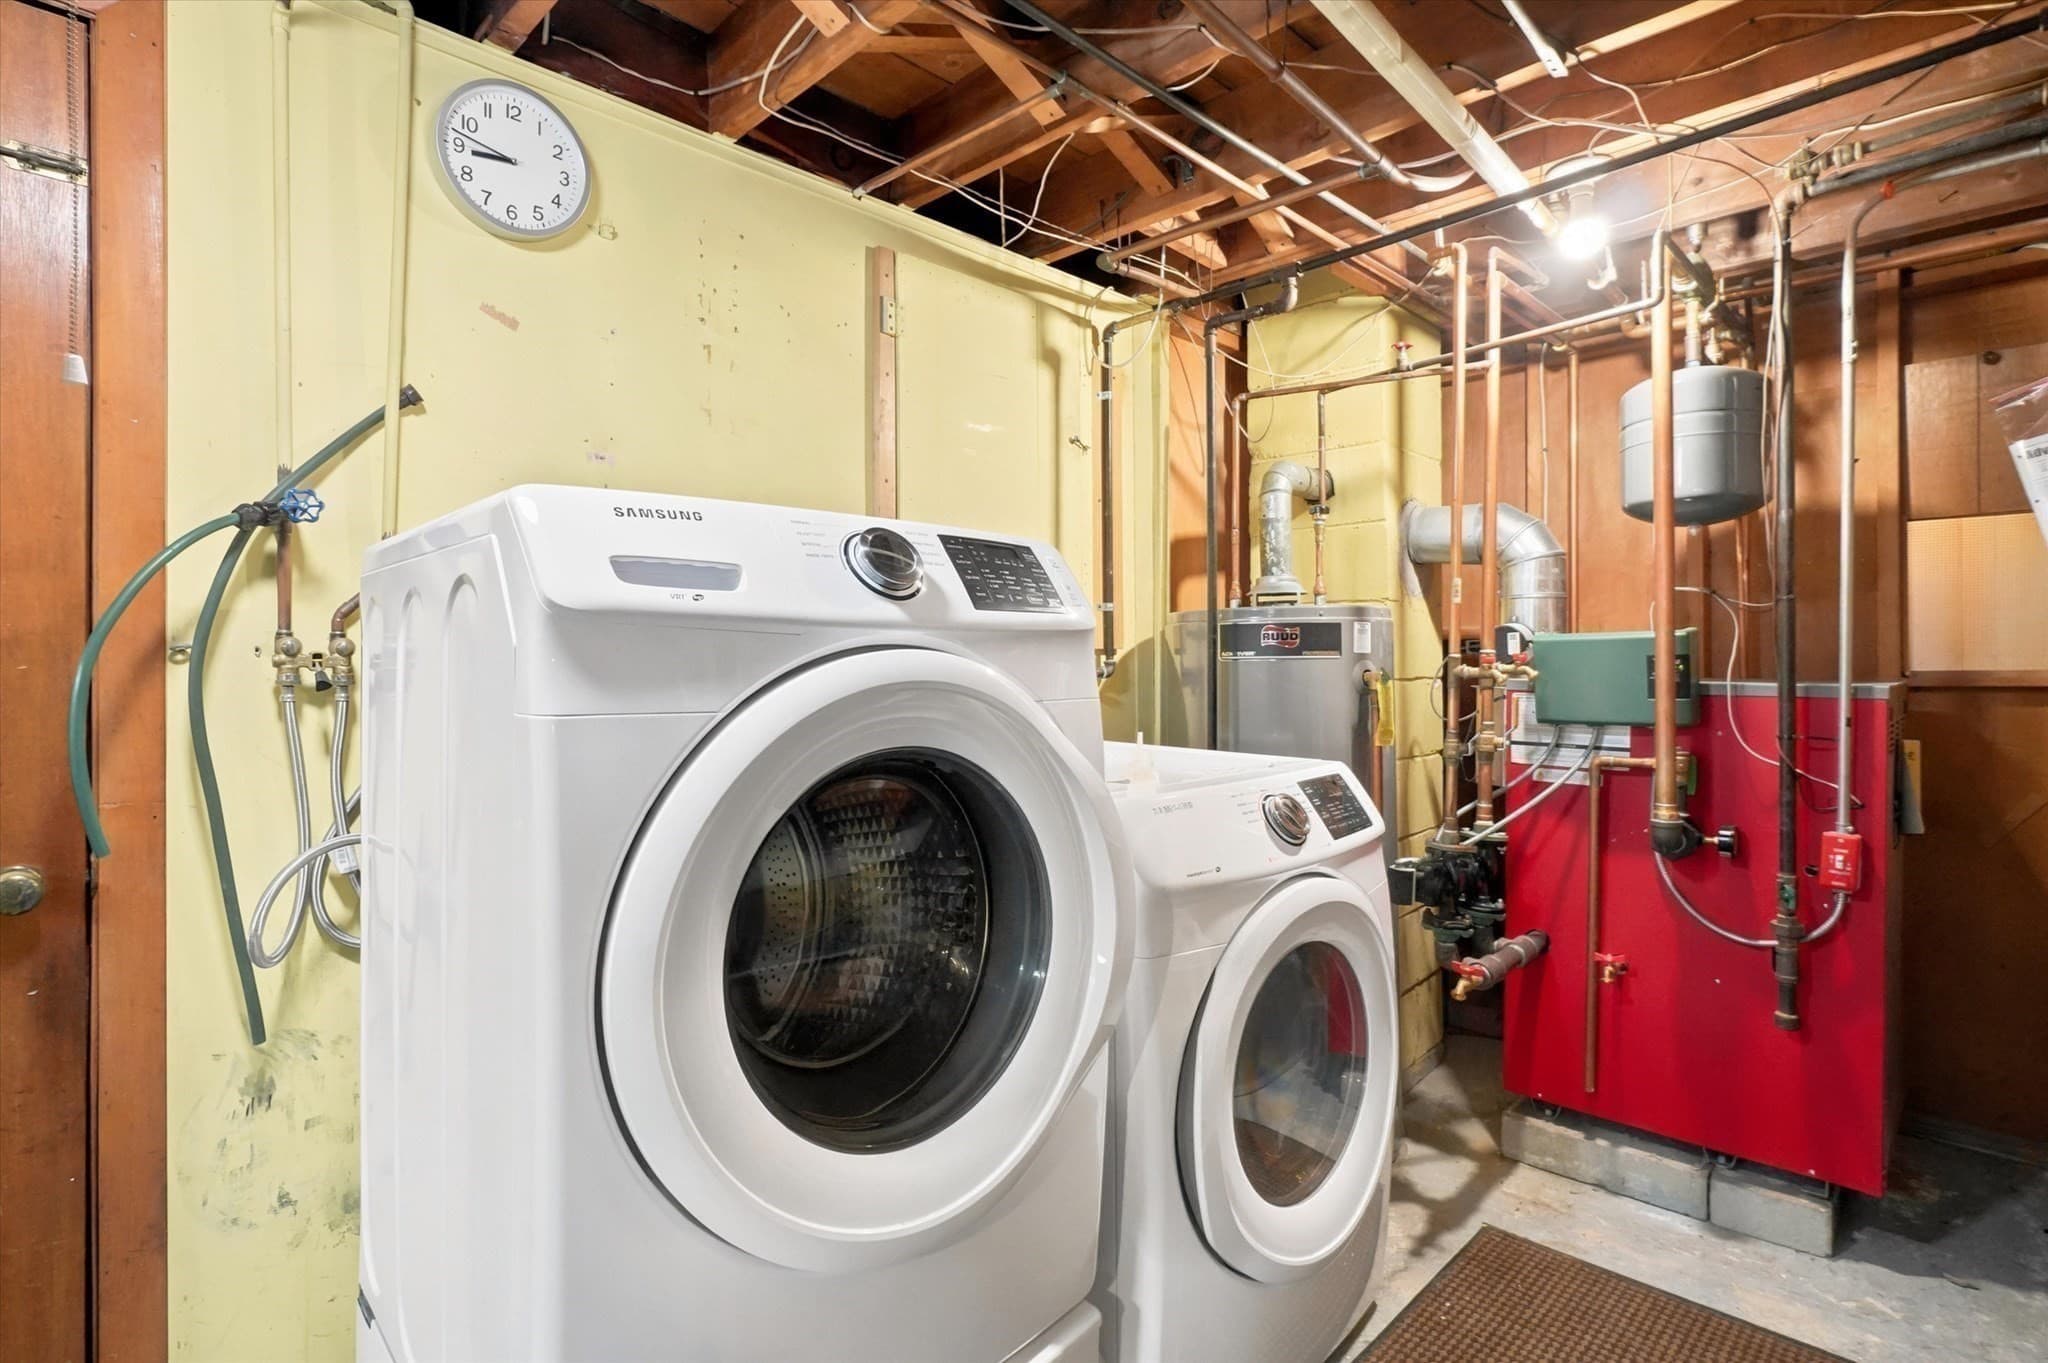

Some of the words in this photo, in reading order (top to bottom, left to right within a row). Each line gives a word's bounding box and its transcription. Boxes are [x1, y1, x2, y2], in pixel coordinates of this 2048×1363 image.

[483, 101, 492, 119] 11
[506, 103, 522, 123] 12
[461, 114, 479, 133] 10
[452, 136, 465, 153] 9
[552, 144, 563, 160] 2
[460, 165, 473, 182] 8
[559, 170, 570, 187] 3
[480, 189, 492, 206] 7
[551, 193, 562, 209] 4
[506, 204, 518, 221] 6
[532, 205, 544, 221] 5
[613, 506, 703, 521] SAMSUNG
[1262, 631, 1298, 641] RUUD
